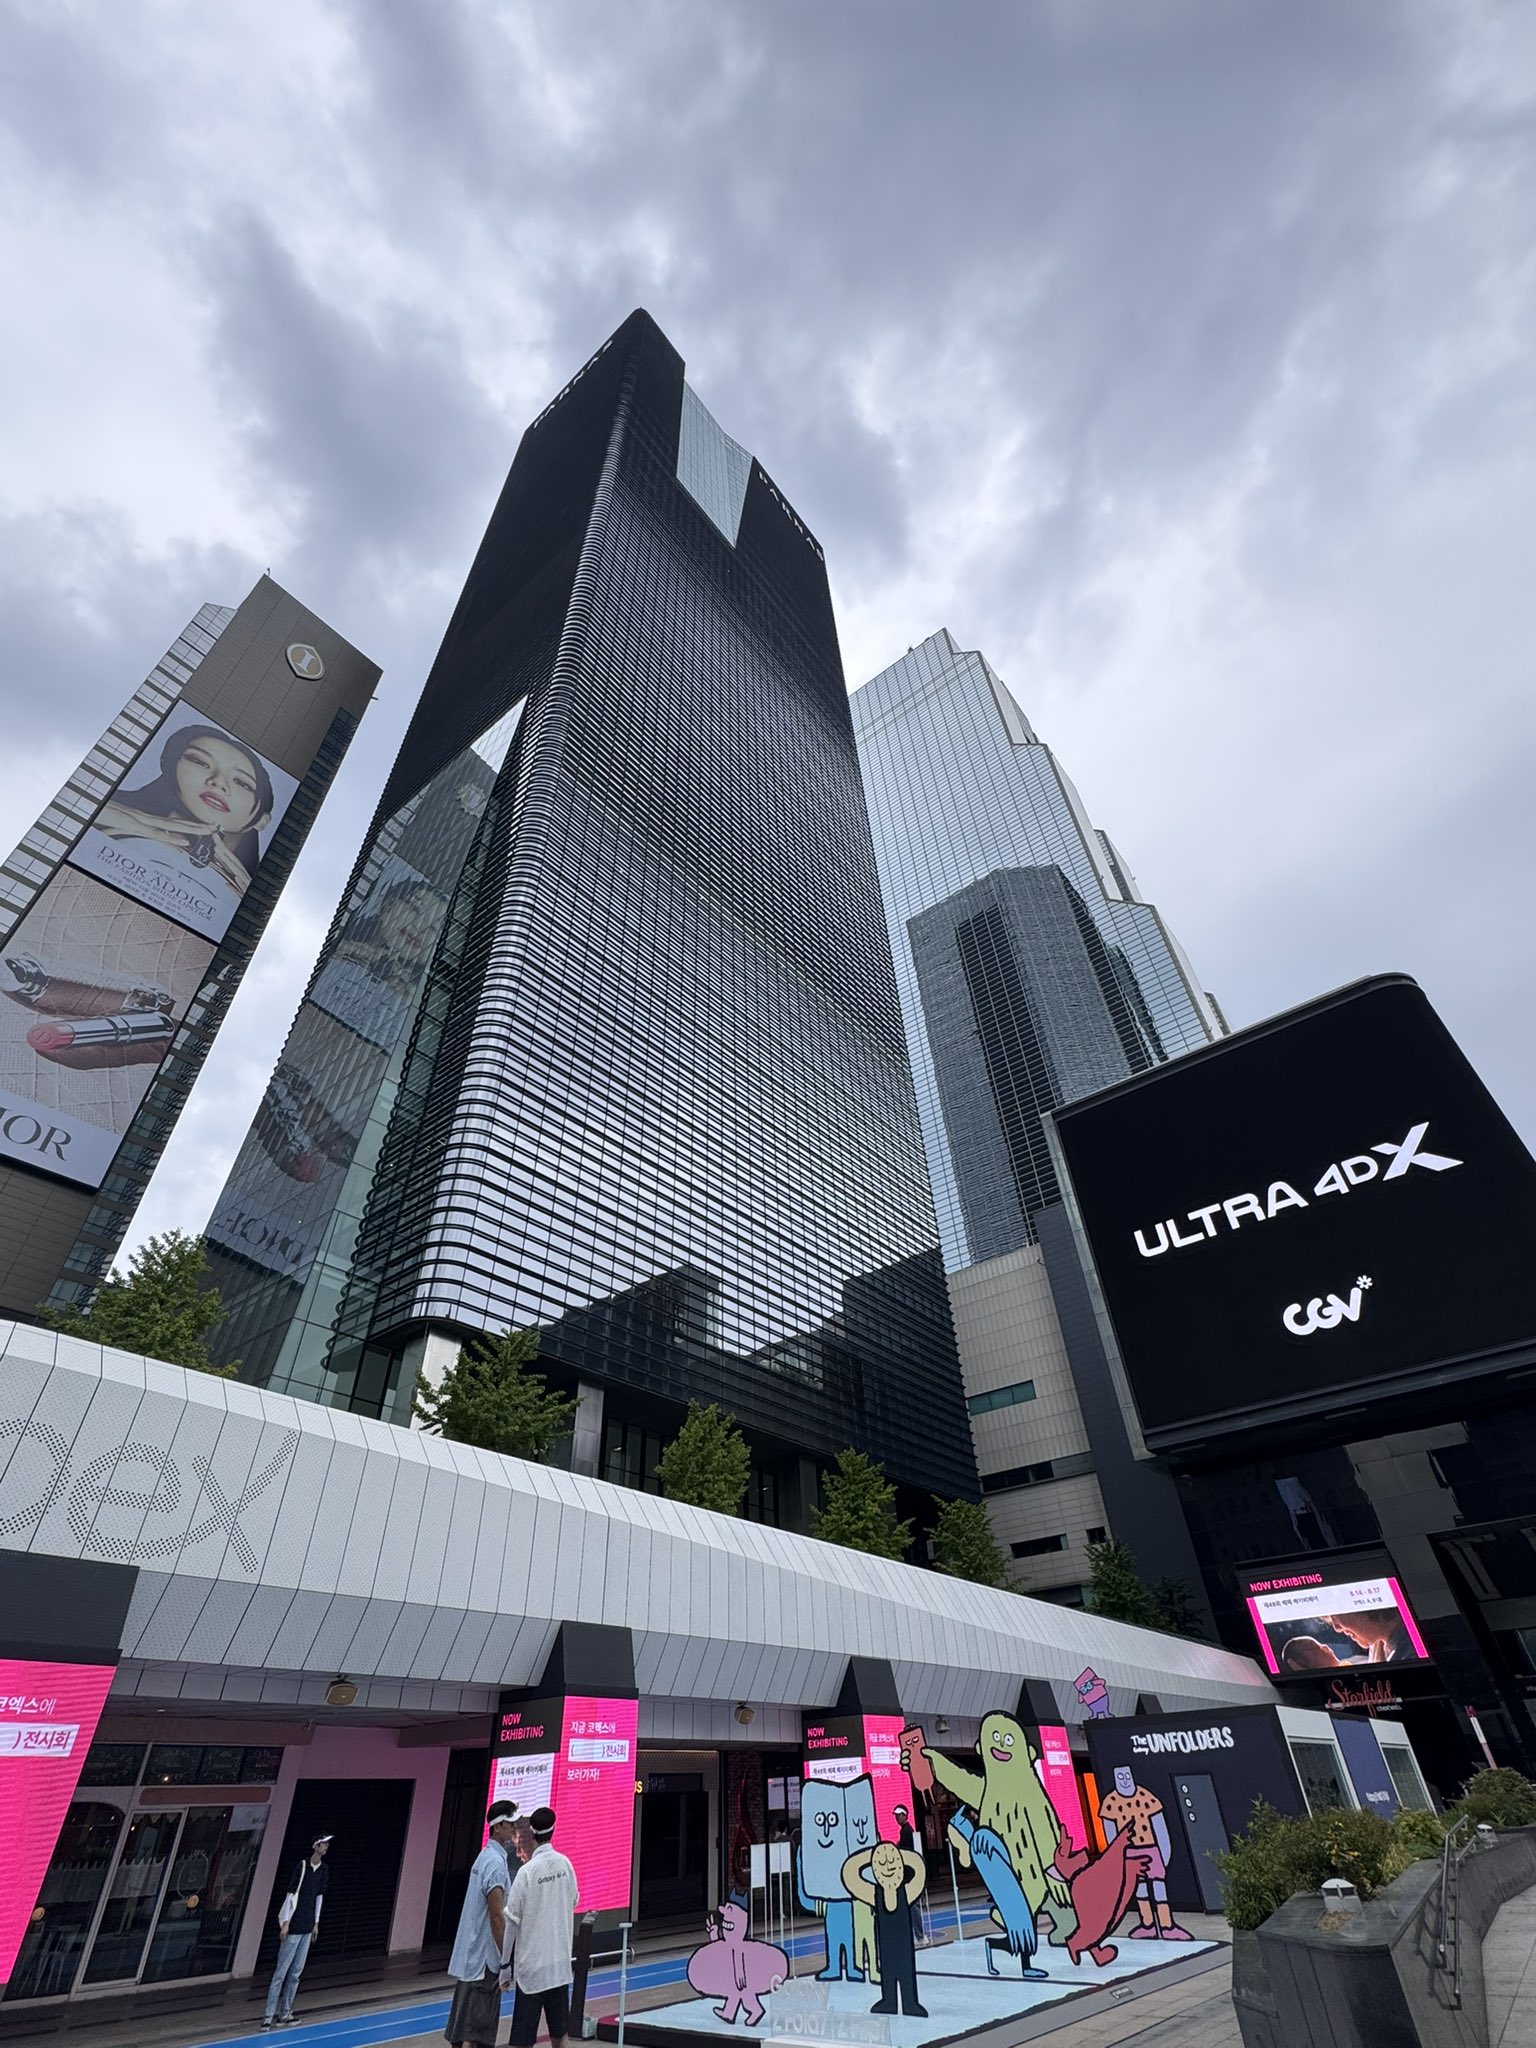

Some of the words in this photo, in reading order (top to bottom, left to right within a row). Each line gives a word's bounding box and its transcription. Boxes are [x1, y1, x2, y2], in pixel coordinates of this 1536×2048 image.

[100, 846, 147, 877] DIOR
[150, 876, 217, 915] ADDICT
[1134, 1181, 1309, 1257] ULTRA
[1314, 1122, 1464, 1196] 4DX
[1283, 1286, 1363, 1335] CGV
[1250, 1581, 1272, 1592] NOW
[1272, 1573, 1323, 1590] EXHIBITING
[1327, 1679, 1394, 1718] Starfield
[502, 1713, 521, 1726] NOW
[571, 1721, 586, 1734] 지금
[587, 1721, 616, 1734] 코엑스에
[500, 1725, 544, 1741] EXHIBITING
[807, 1727, 825, 1737] NOW
[1130, 1735, 1147, 1746] The
[1147, 1726, 1235, 1754] UNFOLDERS
[808, 1736, 848, 1749] EXHIBITING
